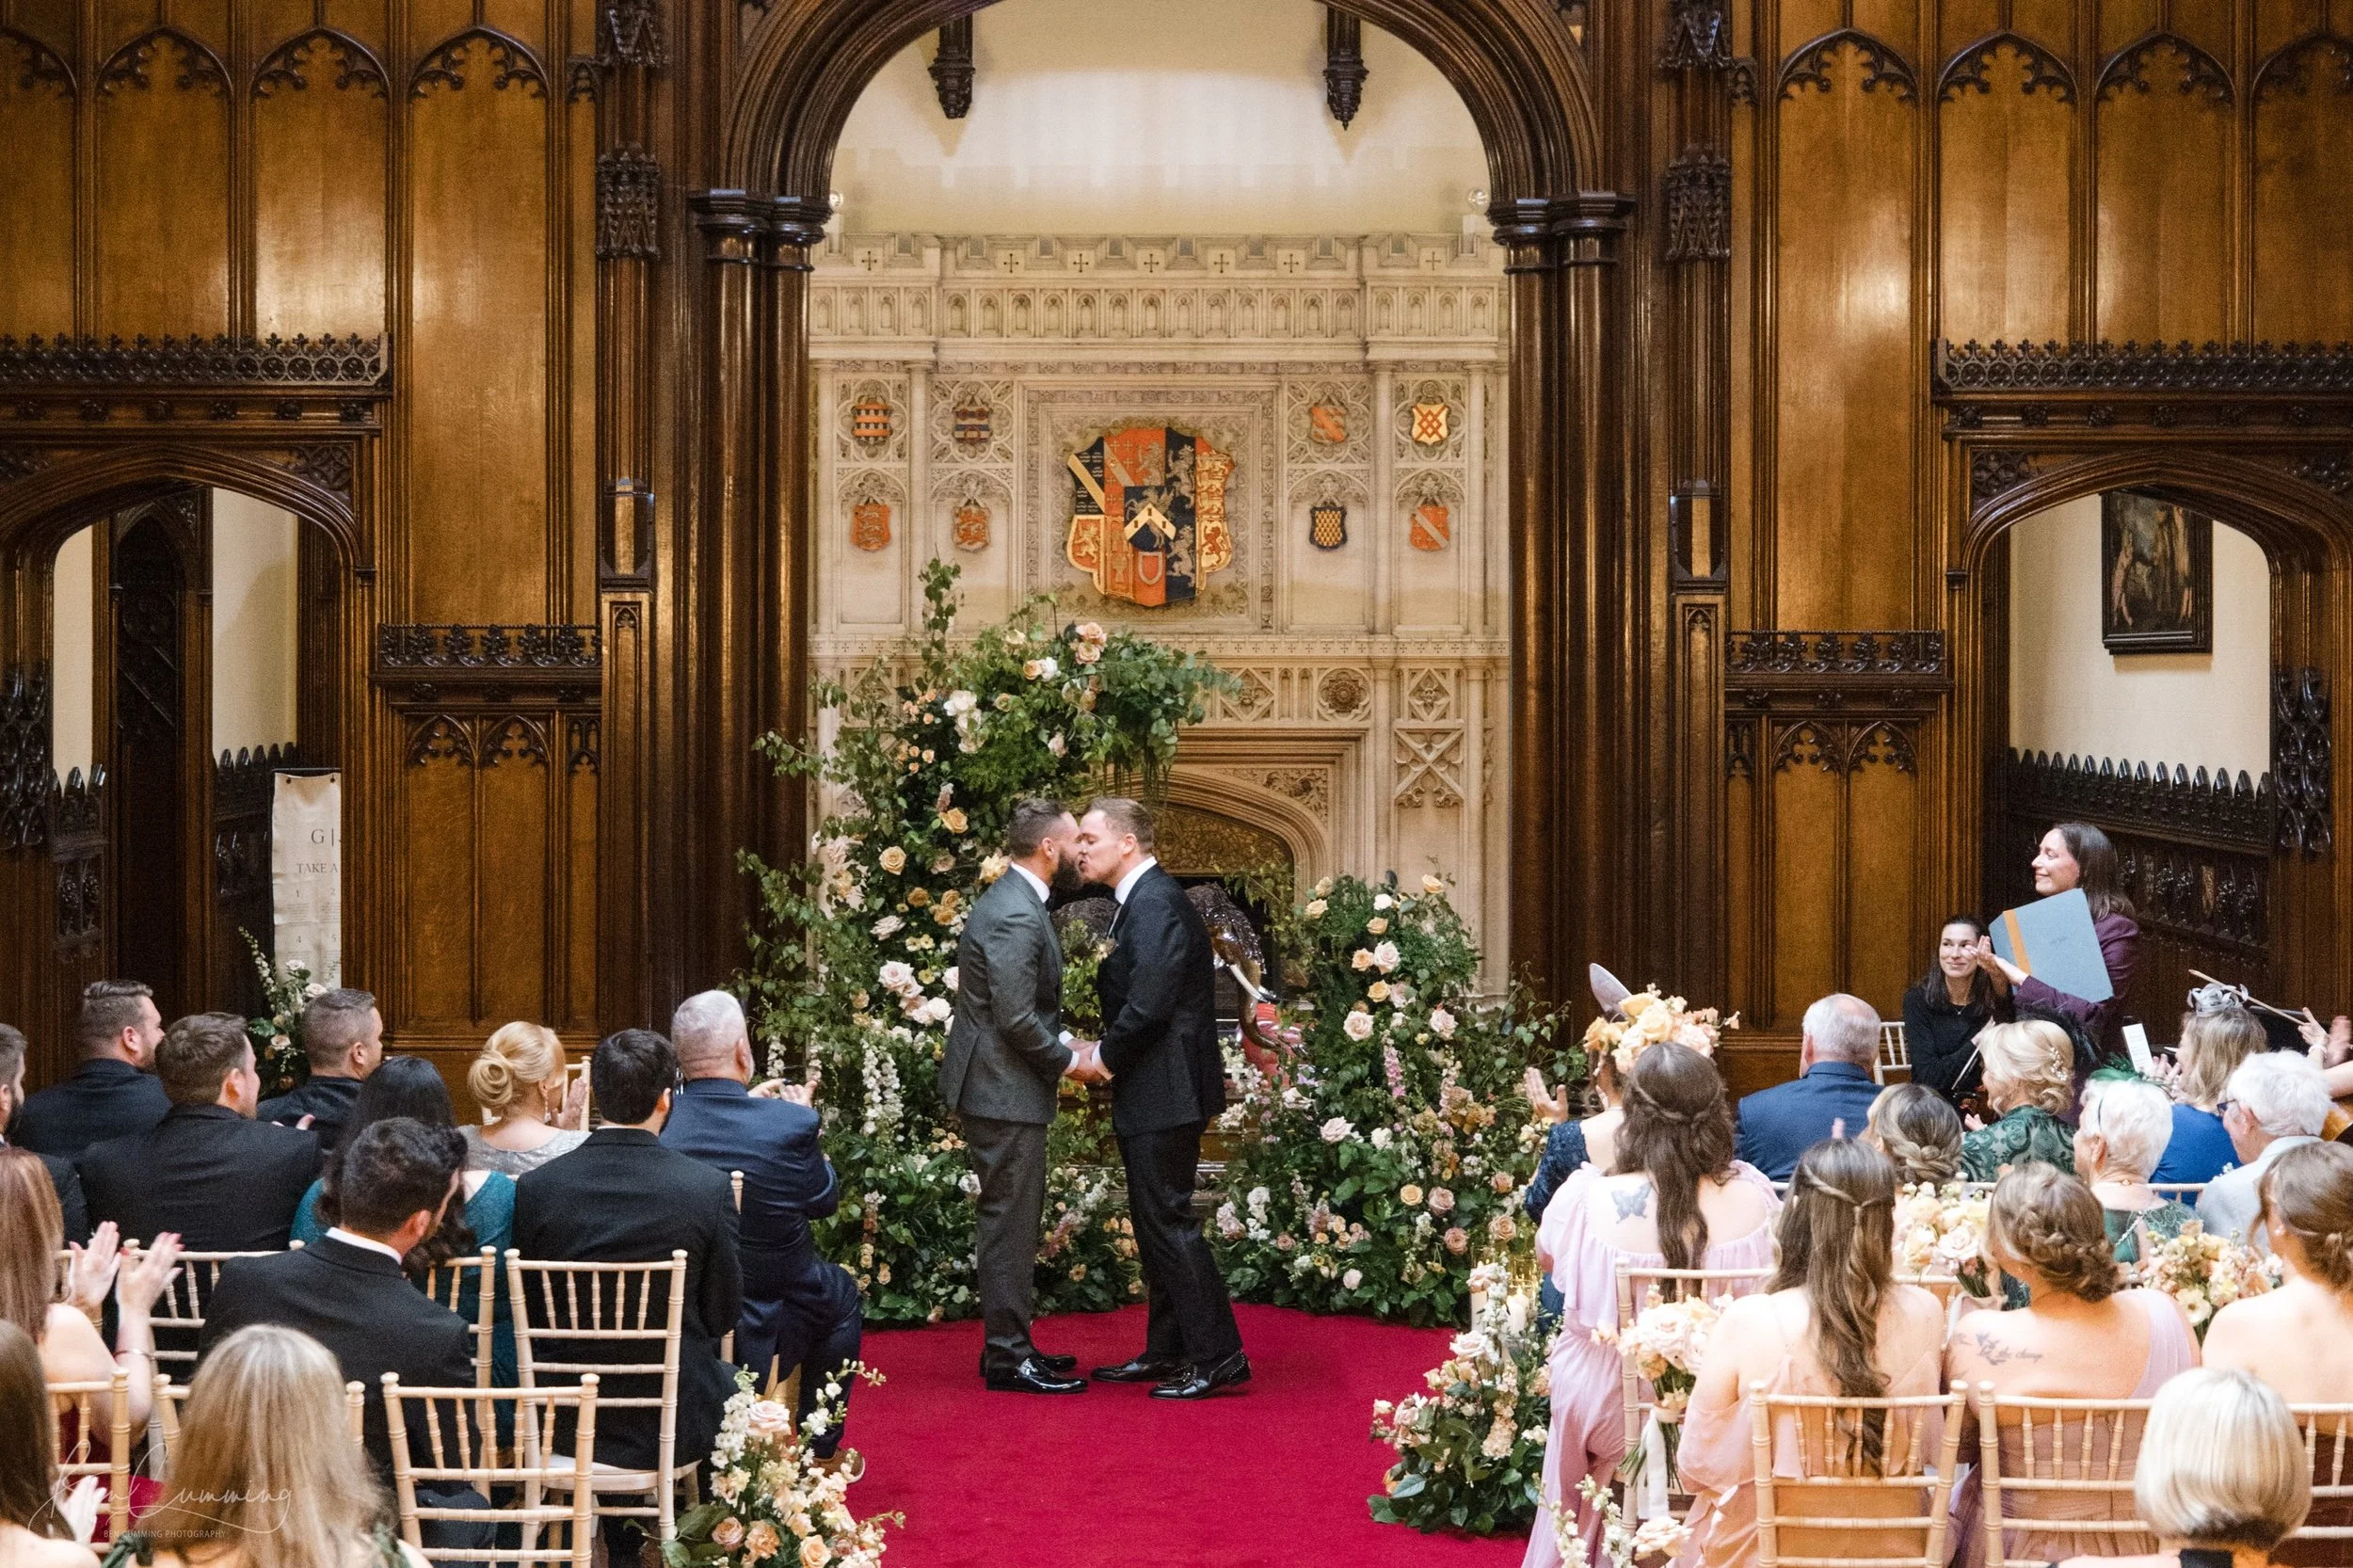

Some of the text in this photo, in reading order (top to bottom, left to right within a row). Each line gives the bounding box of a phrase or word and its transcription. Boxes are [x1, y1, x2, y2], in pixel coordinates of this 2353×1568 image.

[311, 828, 325, 845] G
[296, 862, 339, 874] TAKE A
